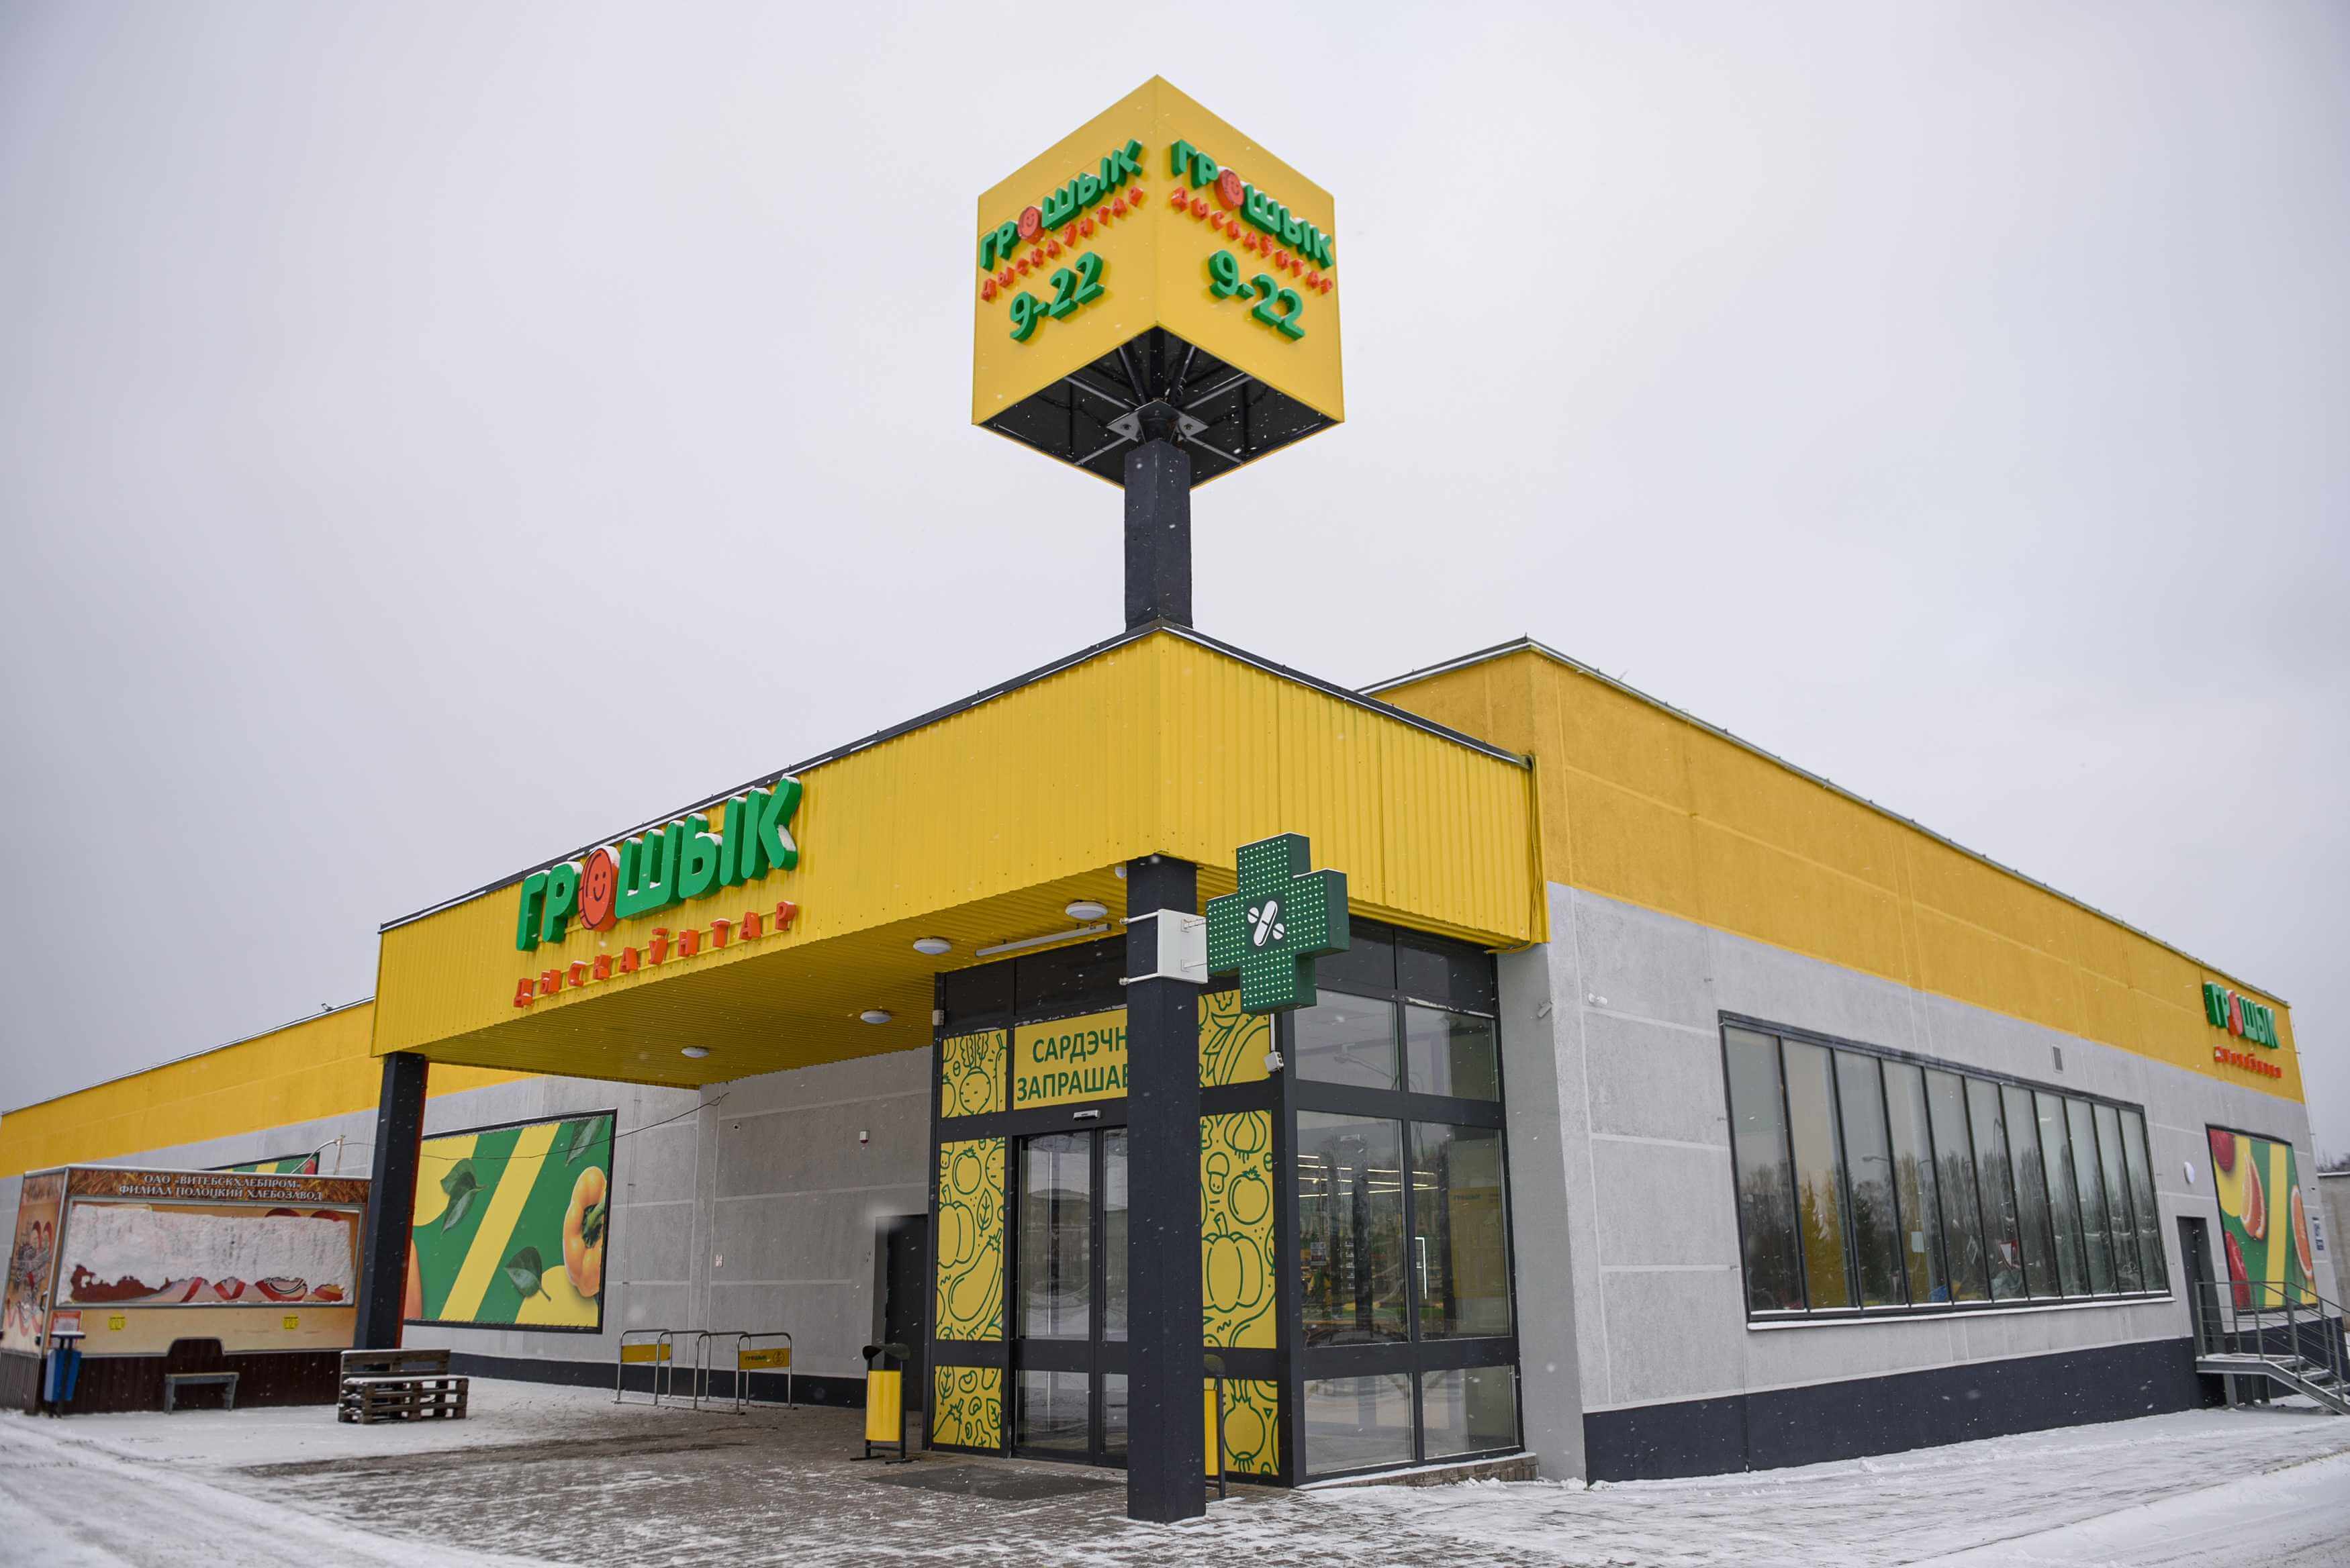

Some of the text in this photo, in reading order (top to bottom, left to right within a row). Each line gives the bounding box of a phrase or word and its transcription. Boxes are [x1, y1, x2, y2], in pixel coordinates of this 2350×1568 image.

[979, 139, 1143, 271] ГРОШЫК
[1171, 139, 1333, 270] ГРОШЫК
[1010, 251, 1104, 342] 9-22
[1209, 250, 1305, 341] 9-22
[516, 775, 803, 952] ГРОШЫК
[513, 901, 798, 1008] ДЫСКАЎНТАР
[1017, 1063, 1128, 1102] ЗАПРАШАЕ
[1032, 1025, 1128, 1064] САРДЭЧН
[119, 1183, 323, 1202] ФИЛИАЛ ПОЛОЦКИЙ ХЛЕБОЗАВОД
[143, 1174, 171, 1185] ОАО
